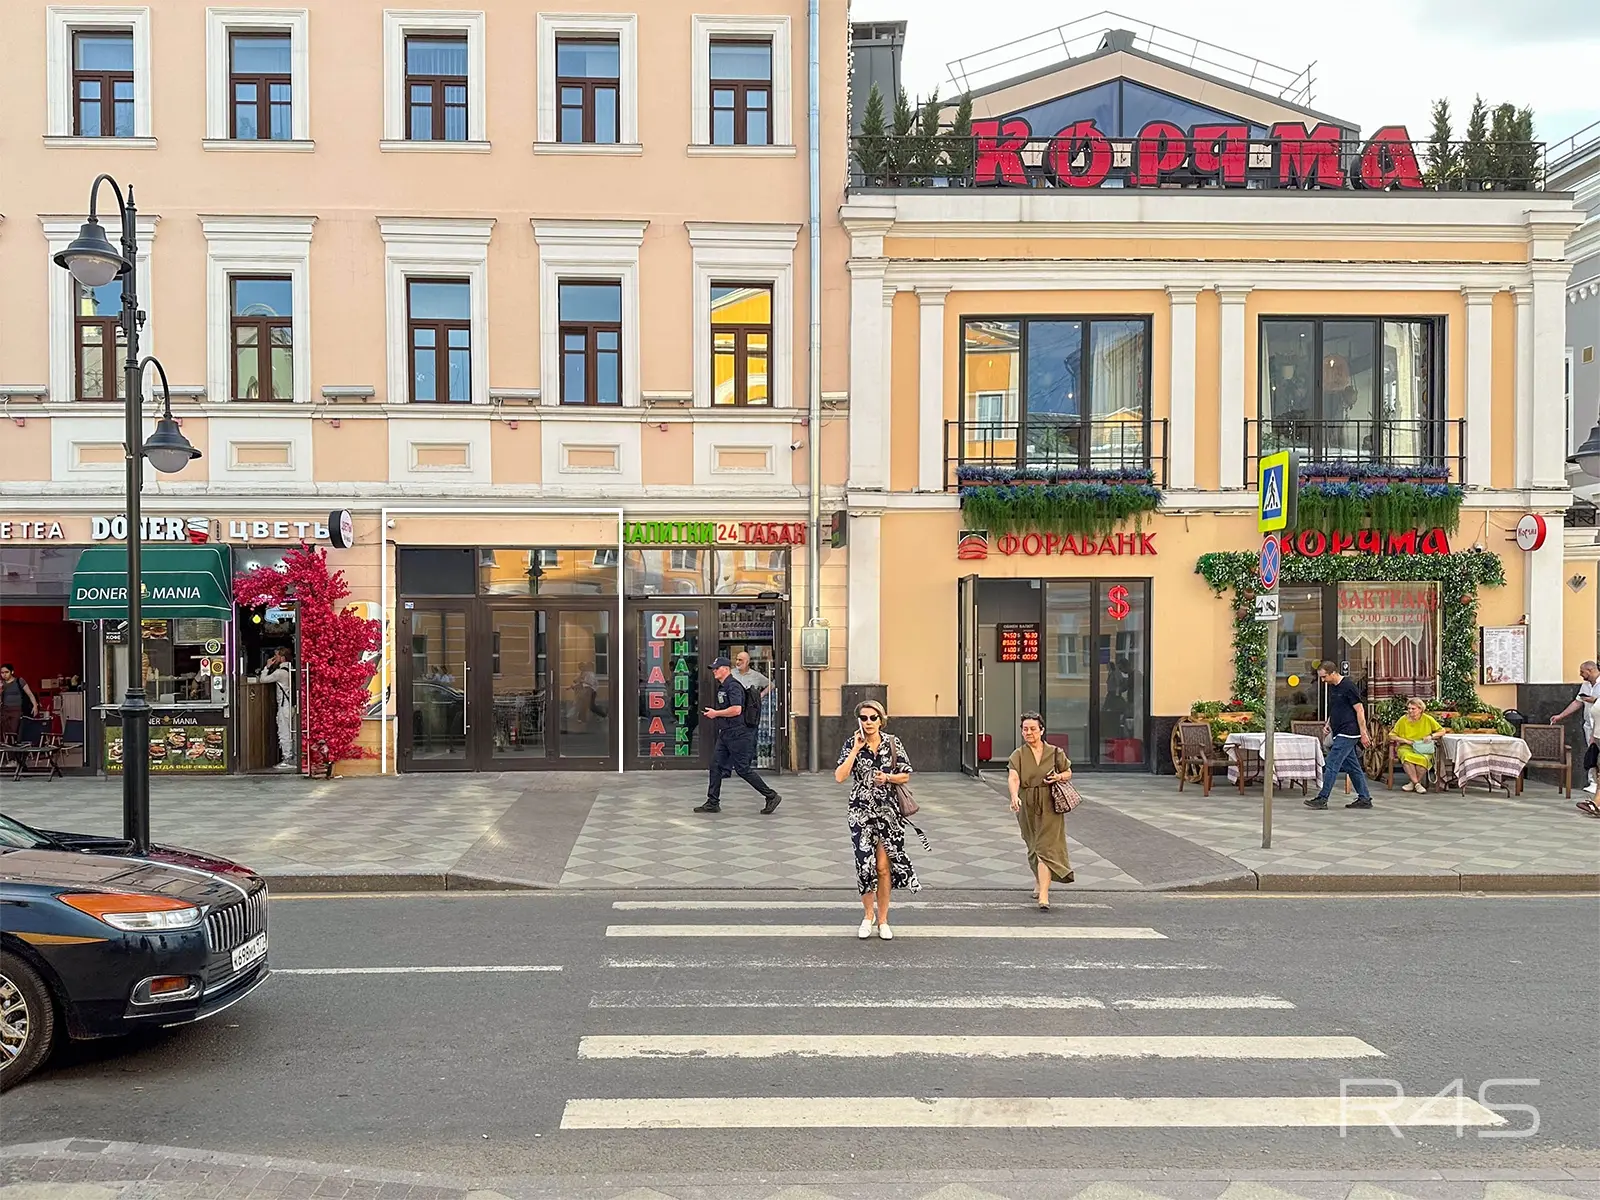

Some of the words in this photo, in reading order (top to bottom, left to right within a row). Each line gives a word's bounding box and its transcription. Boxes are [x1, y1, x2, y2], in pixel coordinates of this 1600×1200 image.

[970, 117, 1425, 190] КОРЧМА
[20, 521, 65, 539] TEA
[718, 524, 738, 541] 24
[742, 521, 807, 545] ТАБАК
[997, 532, 1158, 556] ФОРАБАНК
[76, 587, 128, 600] DONER
[152, 586, 201, 600] MANIA
[655, 615, 681, 637] 24
[647, 640, 667, 757] ТАБАК
[674, 640, 689, 756] НАПИТКИ
[148, 717, 161, 725] NER
[172, 717, 198, 725] MANIA
